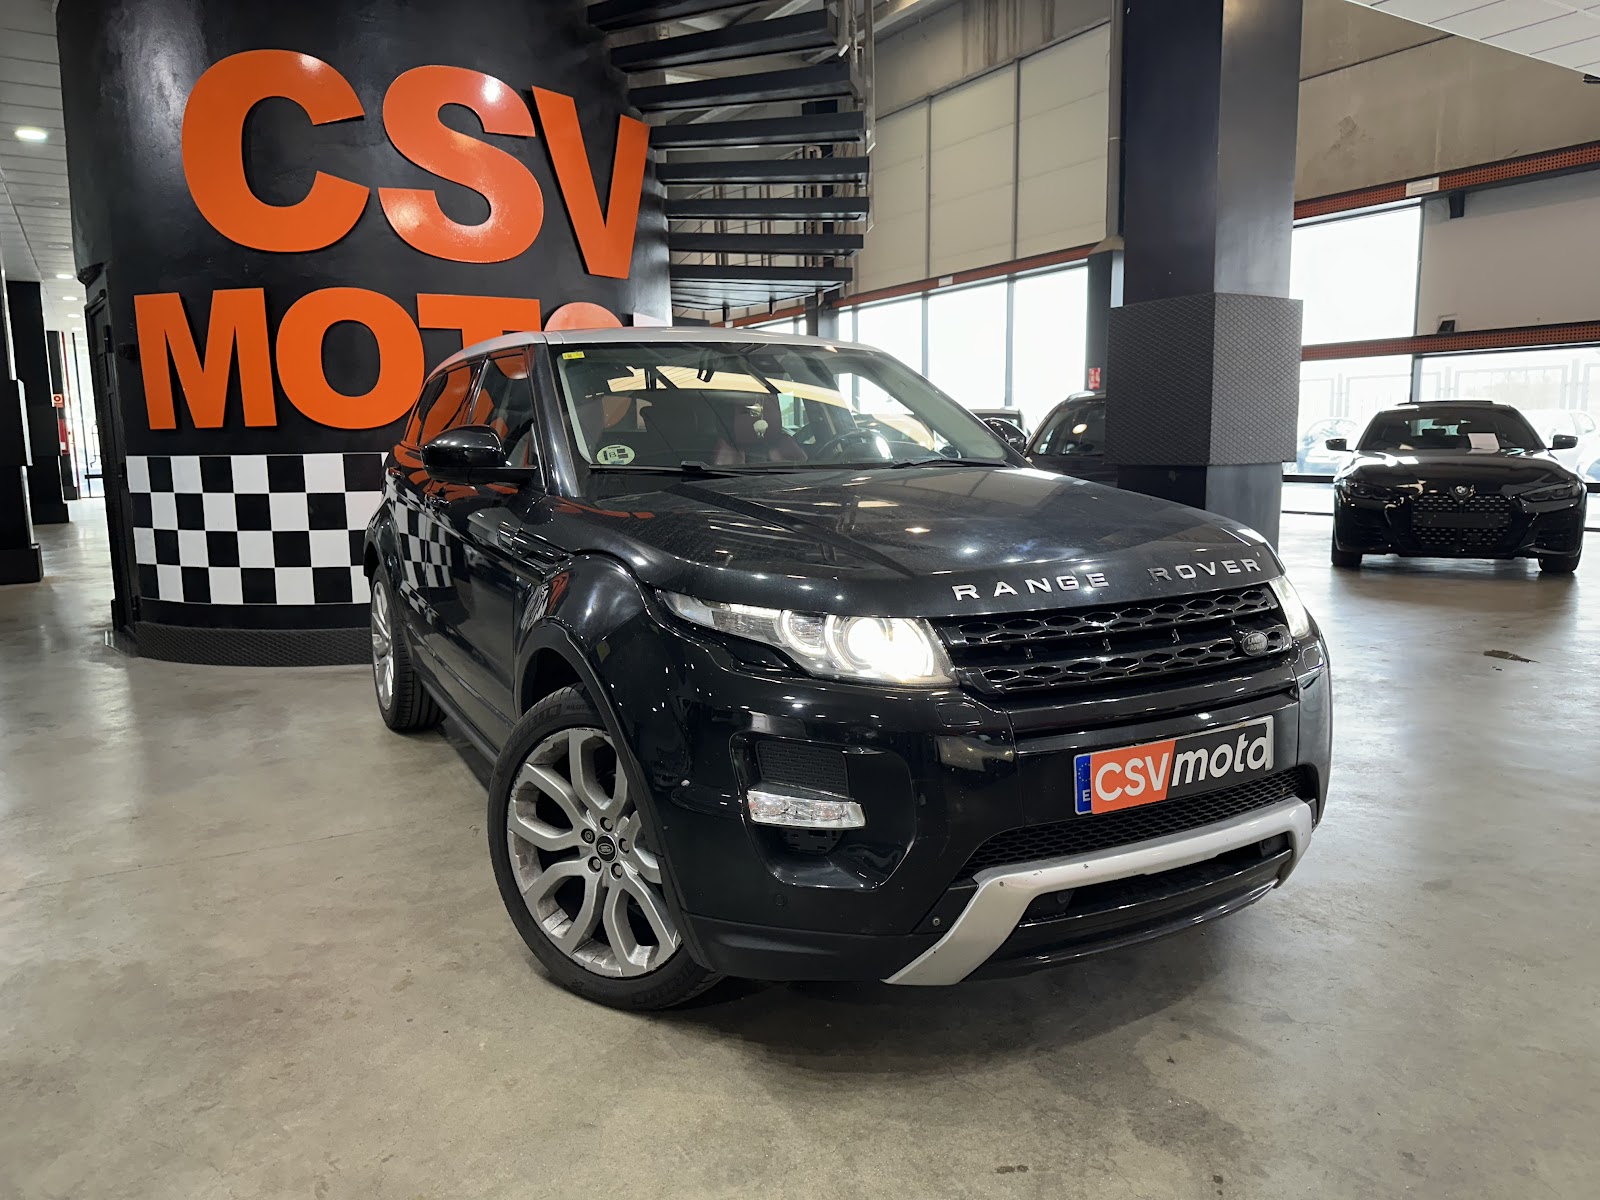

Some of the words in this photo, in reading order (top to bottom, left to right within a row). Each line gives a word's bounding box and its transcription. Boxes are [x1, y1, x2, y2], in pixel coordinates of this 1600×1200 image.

[181, 48, 650, 279] CSV
[952, 572, 1110, 602] RANGE
[1147, 558, 1262, 583] ROVER
